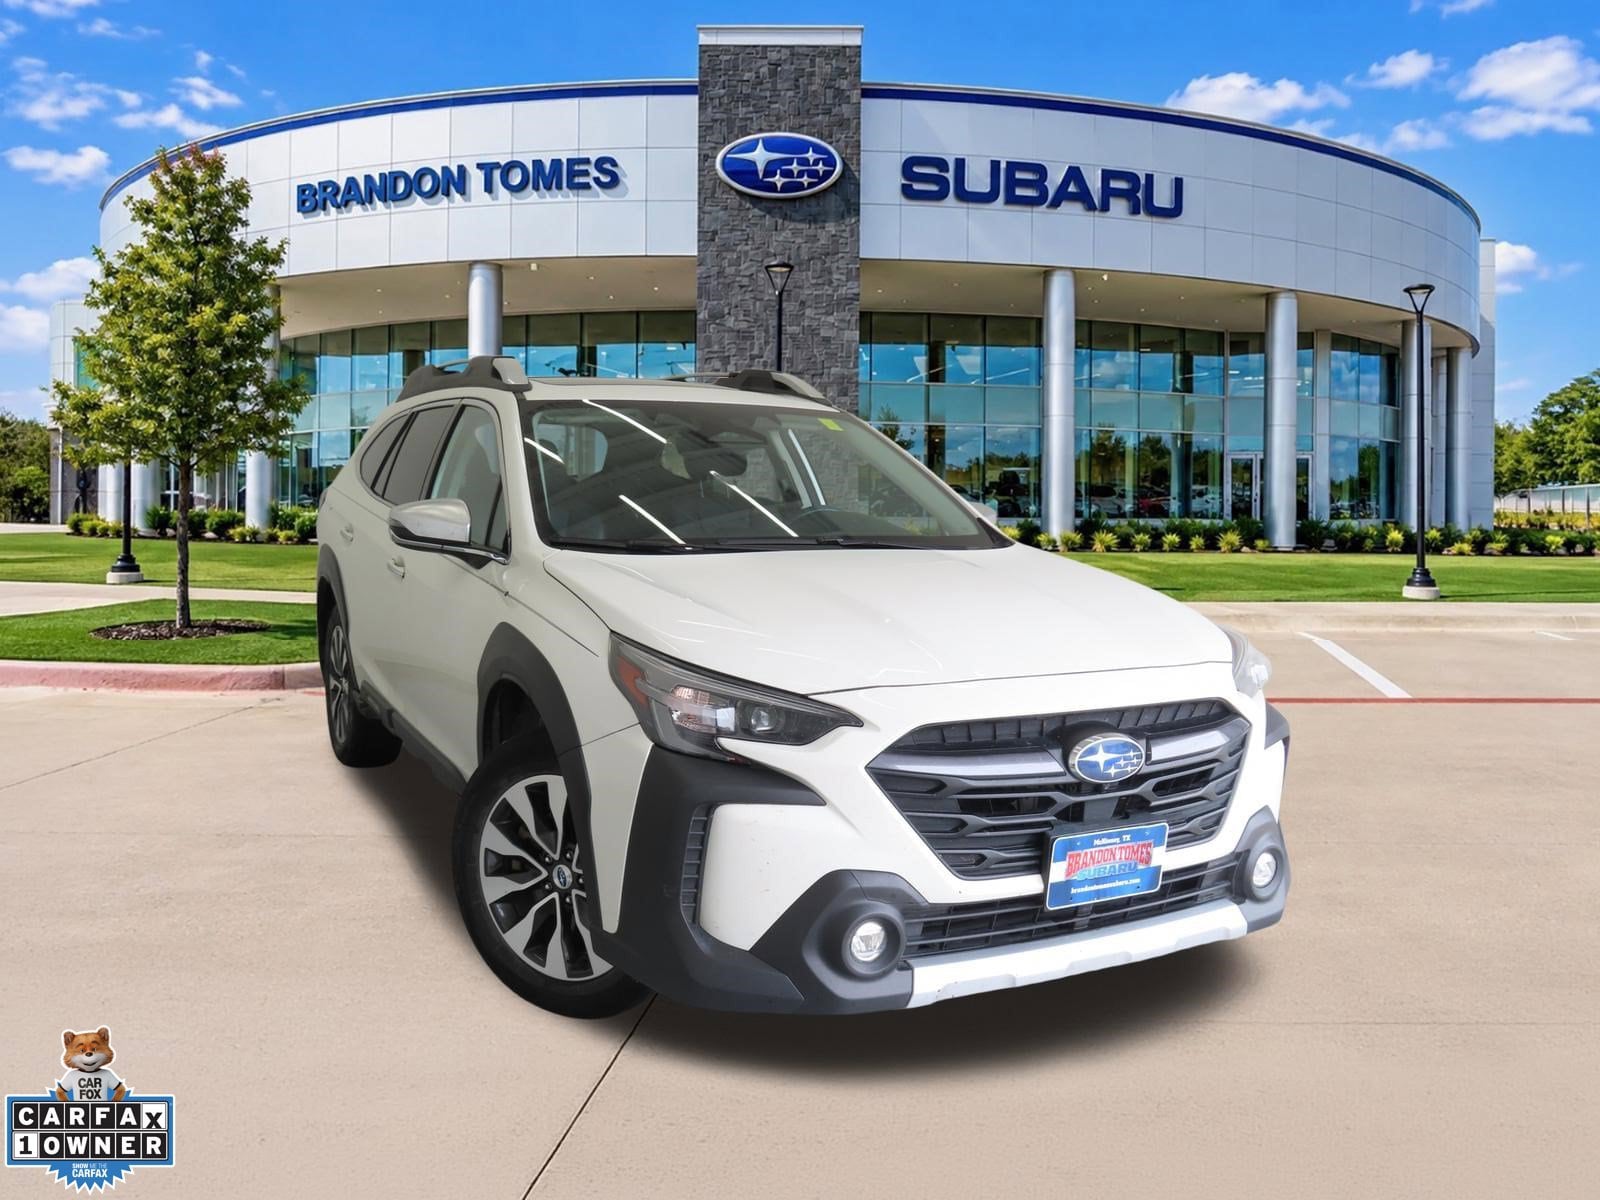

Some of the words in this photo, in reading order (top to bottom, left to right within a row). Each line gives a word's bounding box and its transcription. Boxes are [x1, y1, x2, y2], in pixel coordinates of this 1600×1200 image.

[297, 163, 466, 214] BRANDON
[476, 156, 620, 195] TOMES
[901, 155, 1183, 218] SUBARU
[1122, 834, 1131, 842] TX
[1066, 848, 1117, 878] BRANDON
[1118, 842, 1153, 865] TOMES
[1078, 862, 1137, 880] SUBARU
